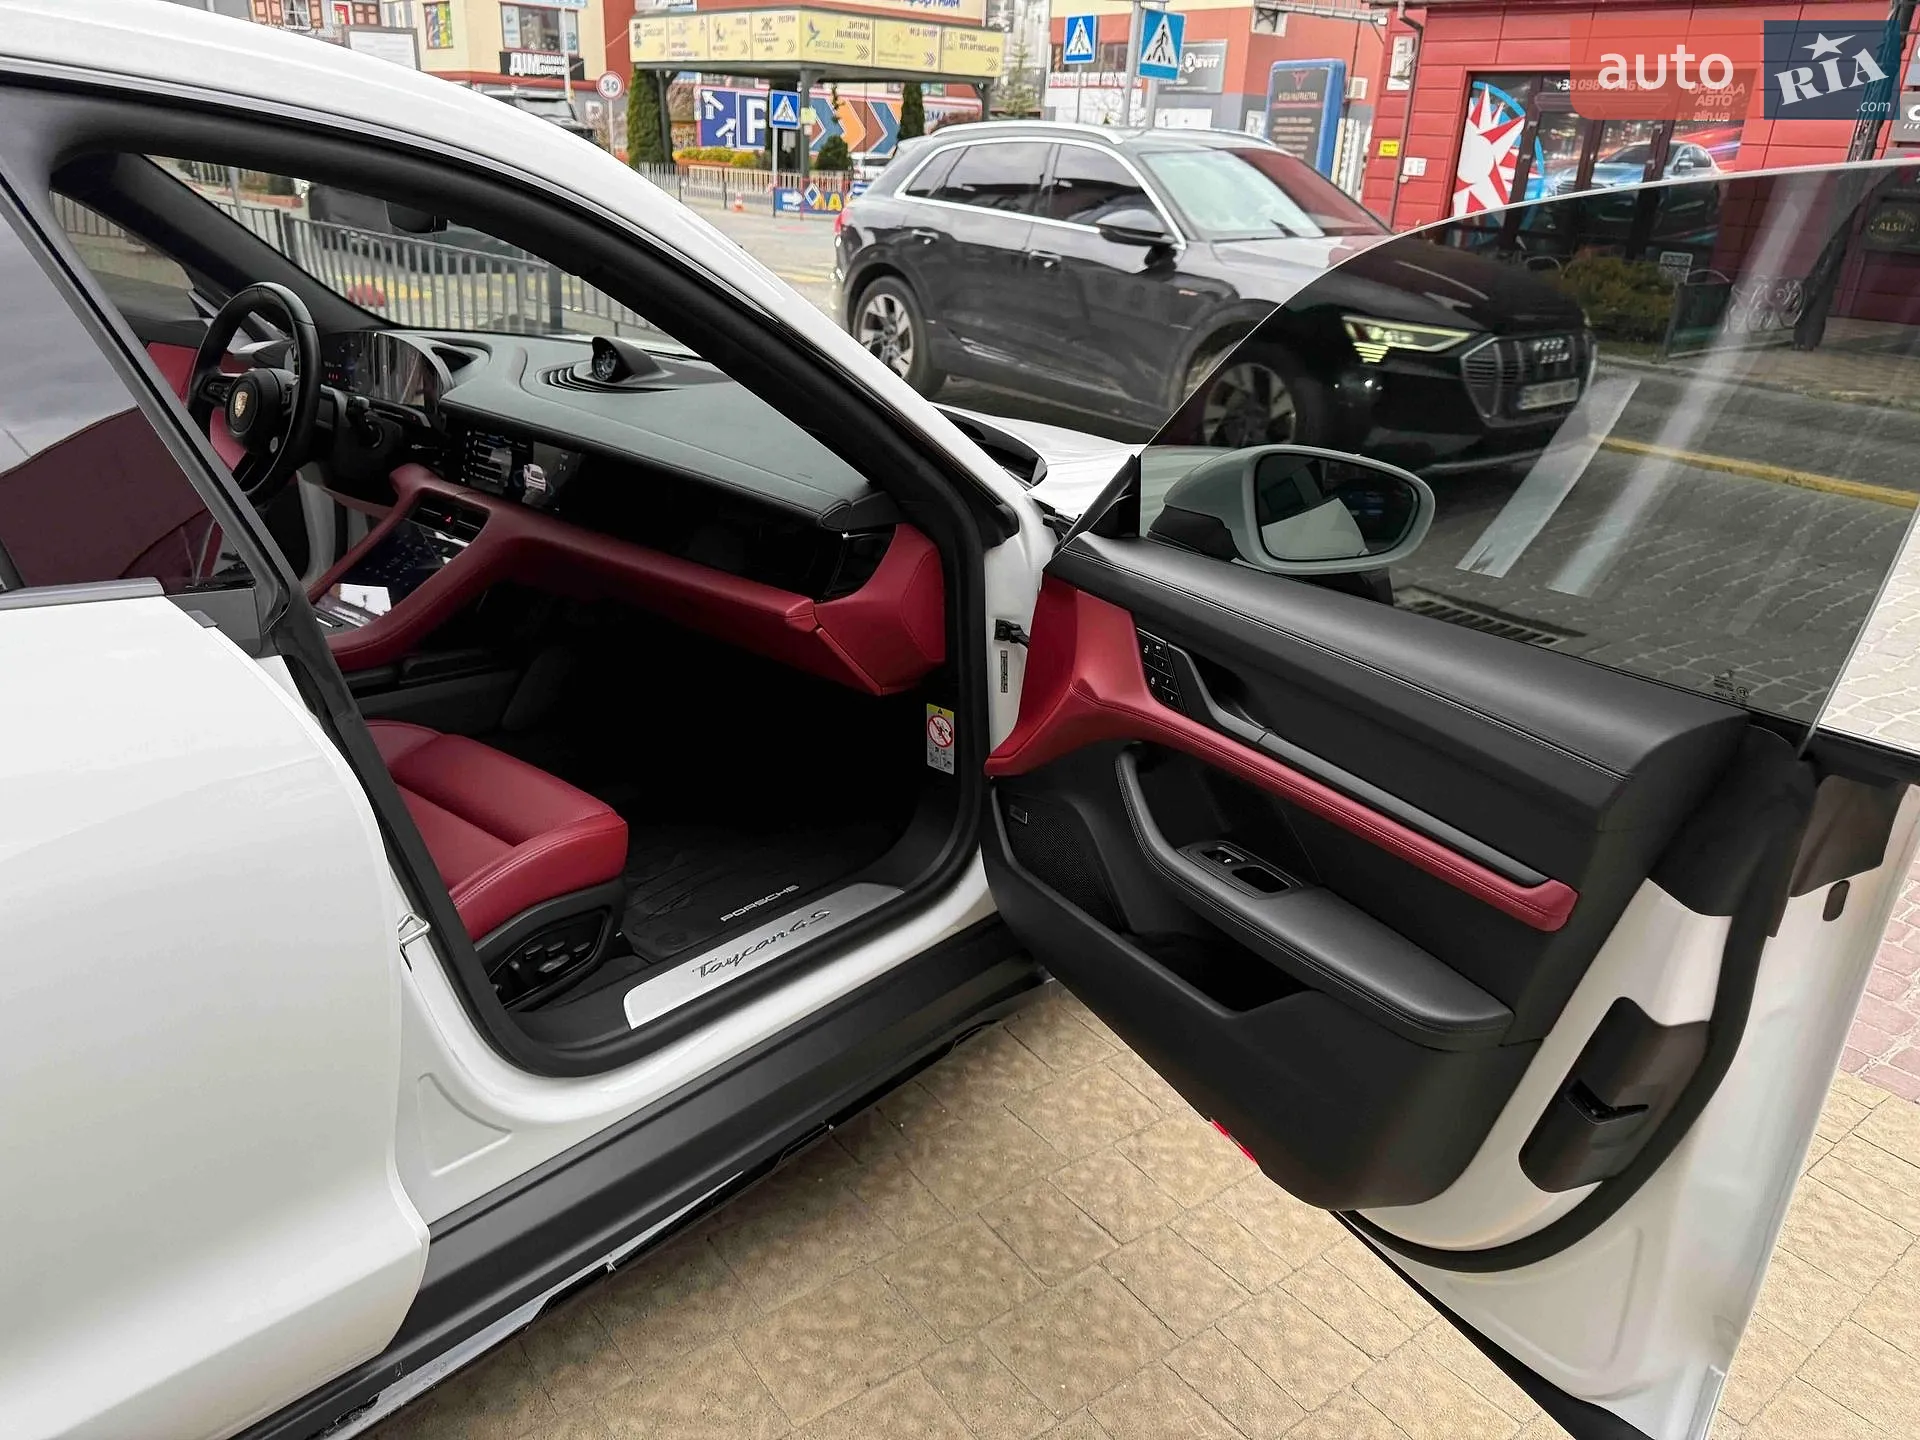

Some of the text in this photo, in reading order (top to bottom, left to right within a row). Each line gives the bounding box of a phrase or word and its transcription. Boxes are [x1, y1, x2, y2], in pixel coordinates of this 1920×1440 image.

[603, 79, 619, 92] 30
[1695, 94, 1733, 107] АВТО
[720, 884, 799, 921] PORSCHE
[691, 930, 787, 978] Taycan
